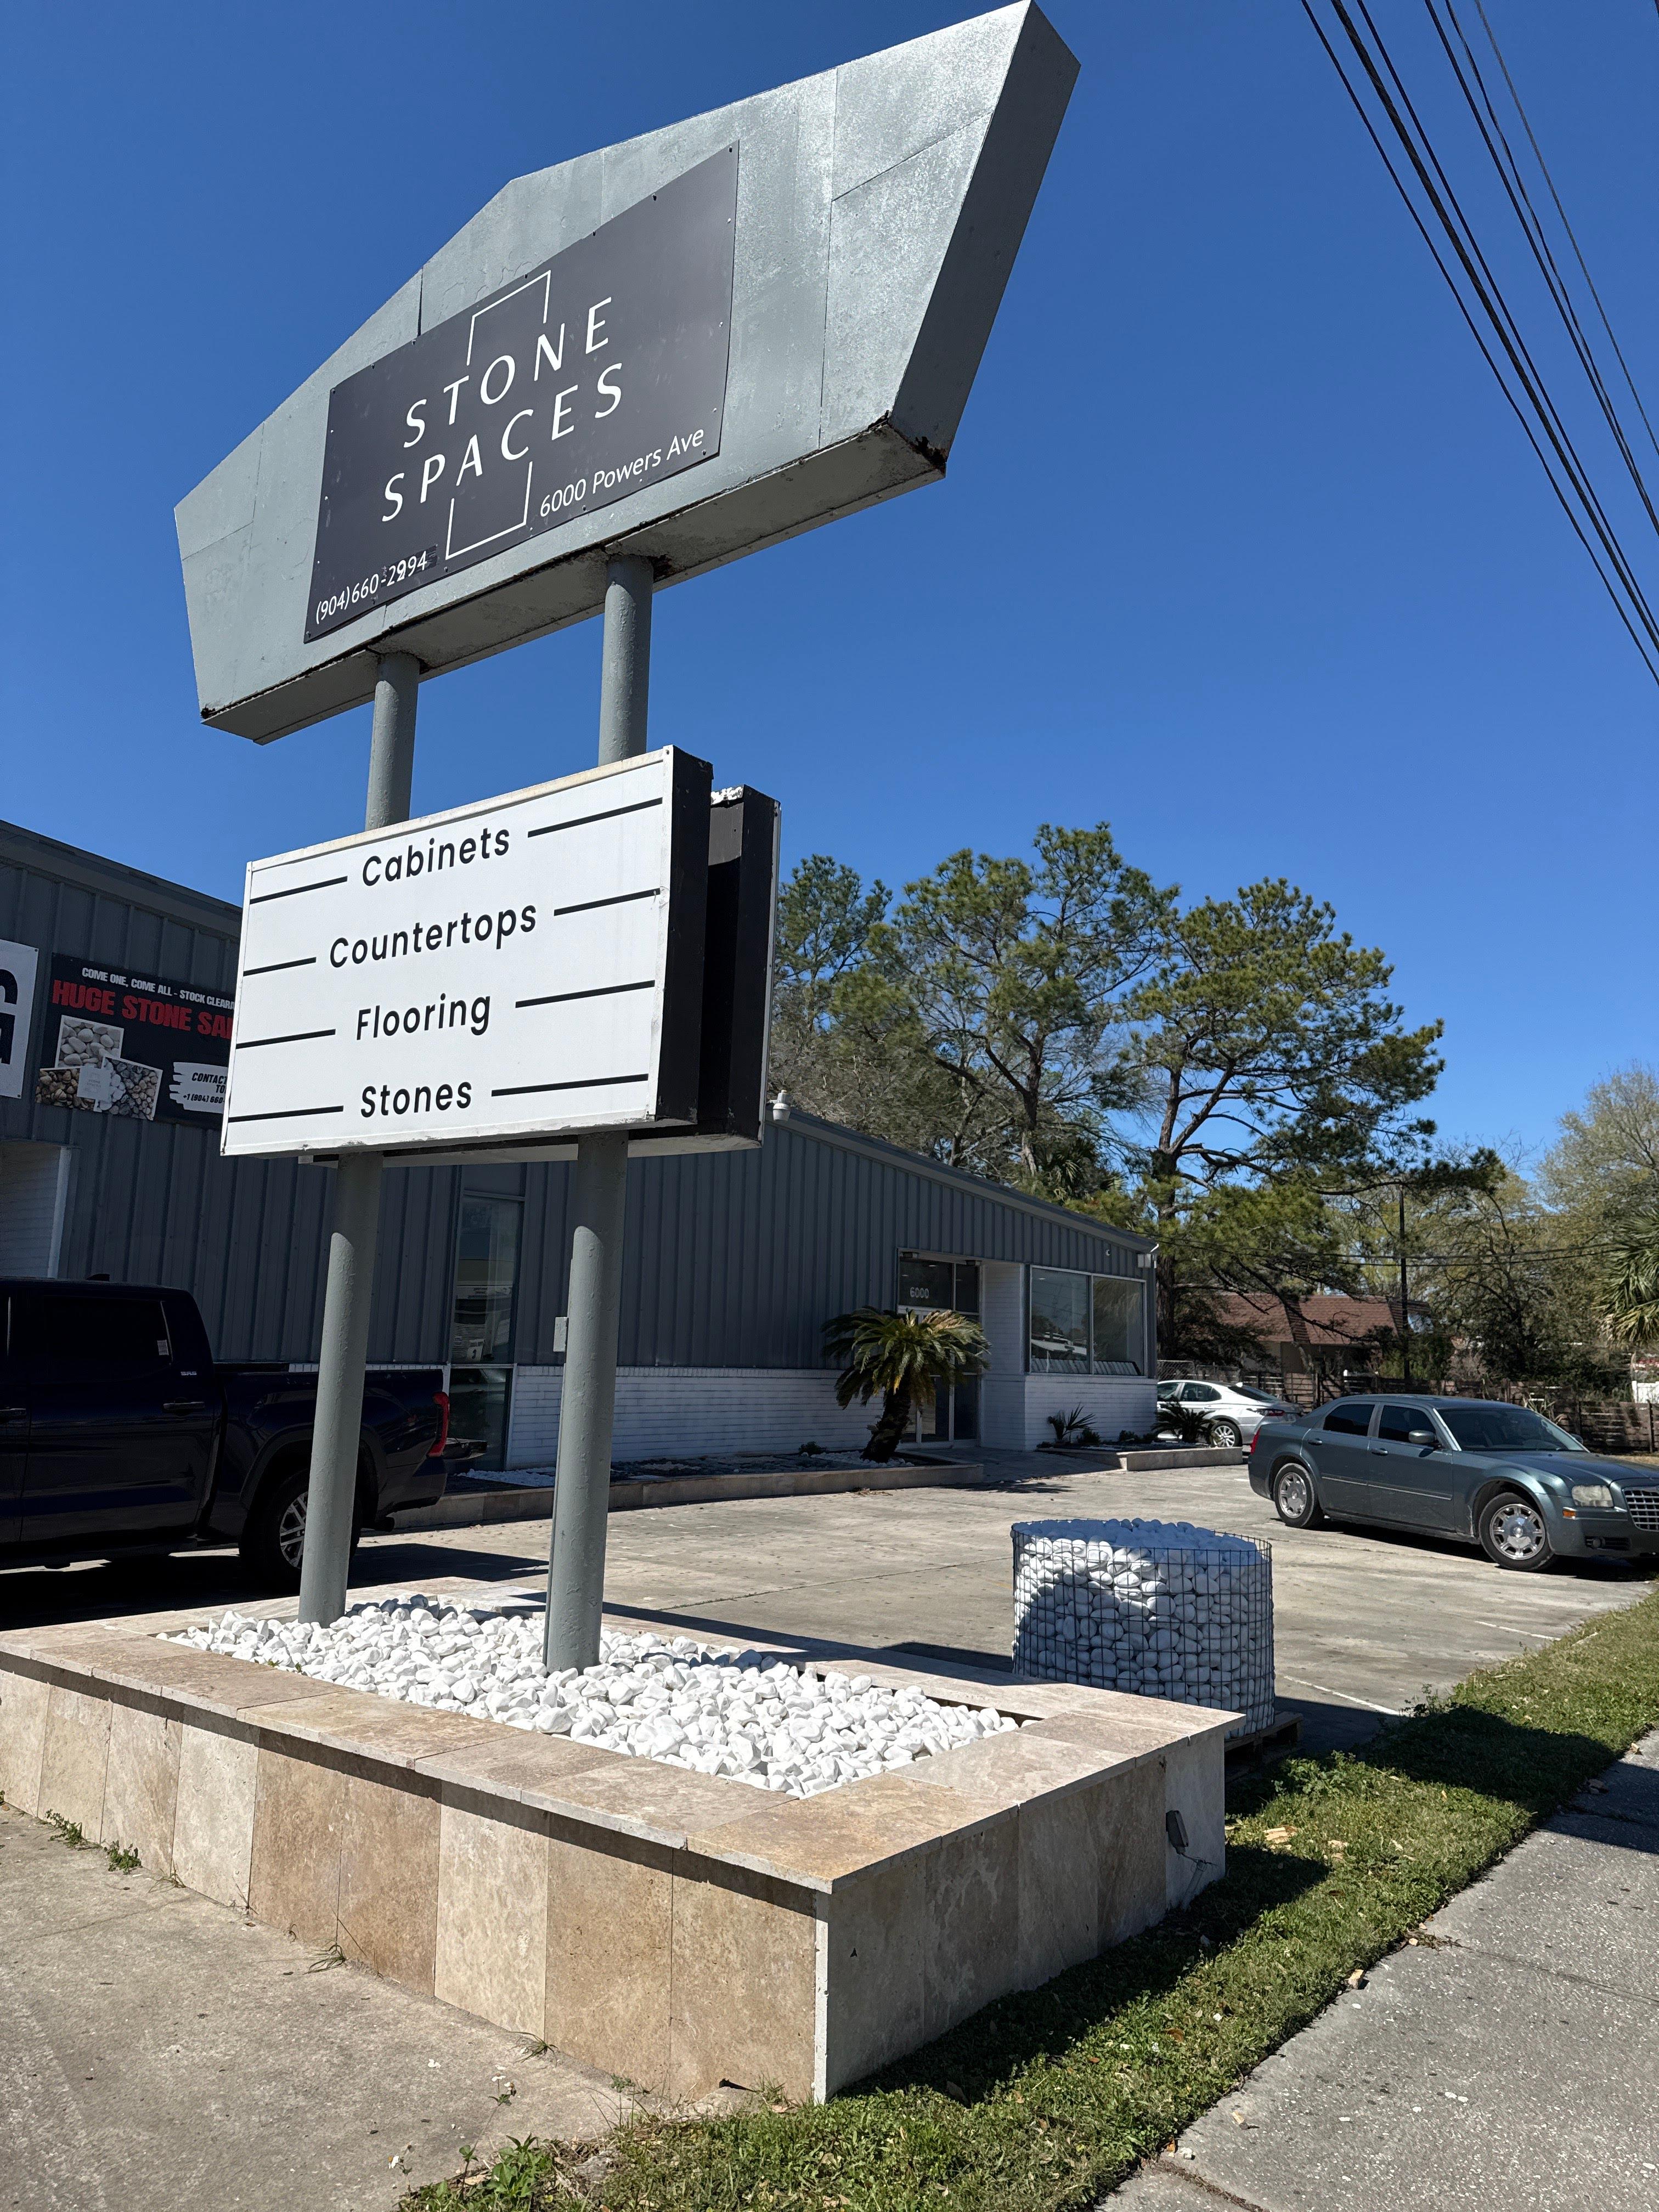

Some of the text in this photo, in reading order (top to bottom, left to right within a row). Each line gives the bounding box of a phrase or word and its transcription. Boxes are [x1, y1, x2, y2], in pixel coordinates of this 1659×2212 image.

[403, 297, 612, 448] STONE
[382, 363, 622, 521] SPACES
[540, 429, 704, 517] 6000 Powers Ave
[363, 827, 509, 887] Cabinets
[330, 905, 536, 968] Countertops
[52, 980, 115, 1015] HUGE
[122, 995, 192, 1031] STONE
[82, 967, 108, 982] COME
[110, 974, 128, 988] ONE,
[131, 978, 155, 992] COME
[157, 985, 172, 997] ALL
[179, 990, 205, 1003] STOCK
[356, 993, 490, 1040] Flooring
[191, 1093, 209, 1103] (904)
[216, 1085, 226, 1094] TO
[360, 1081, 471, 1118] Stones
[910, 1286, 929, 1299] 6000
